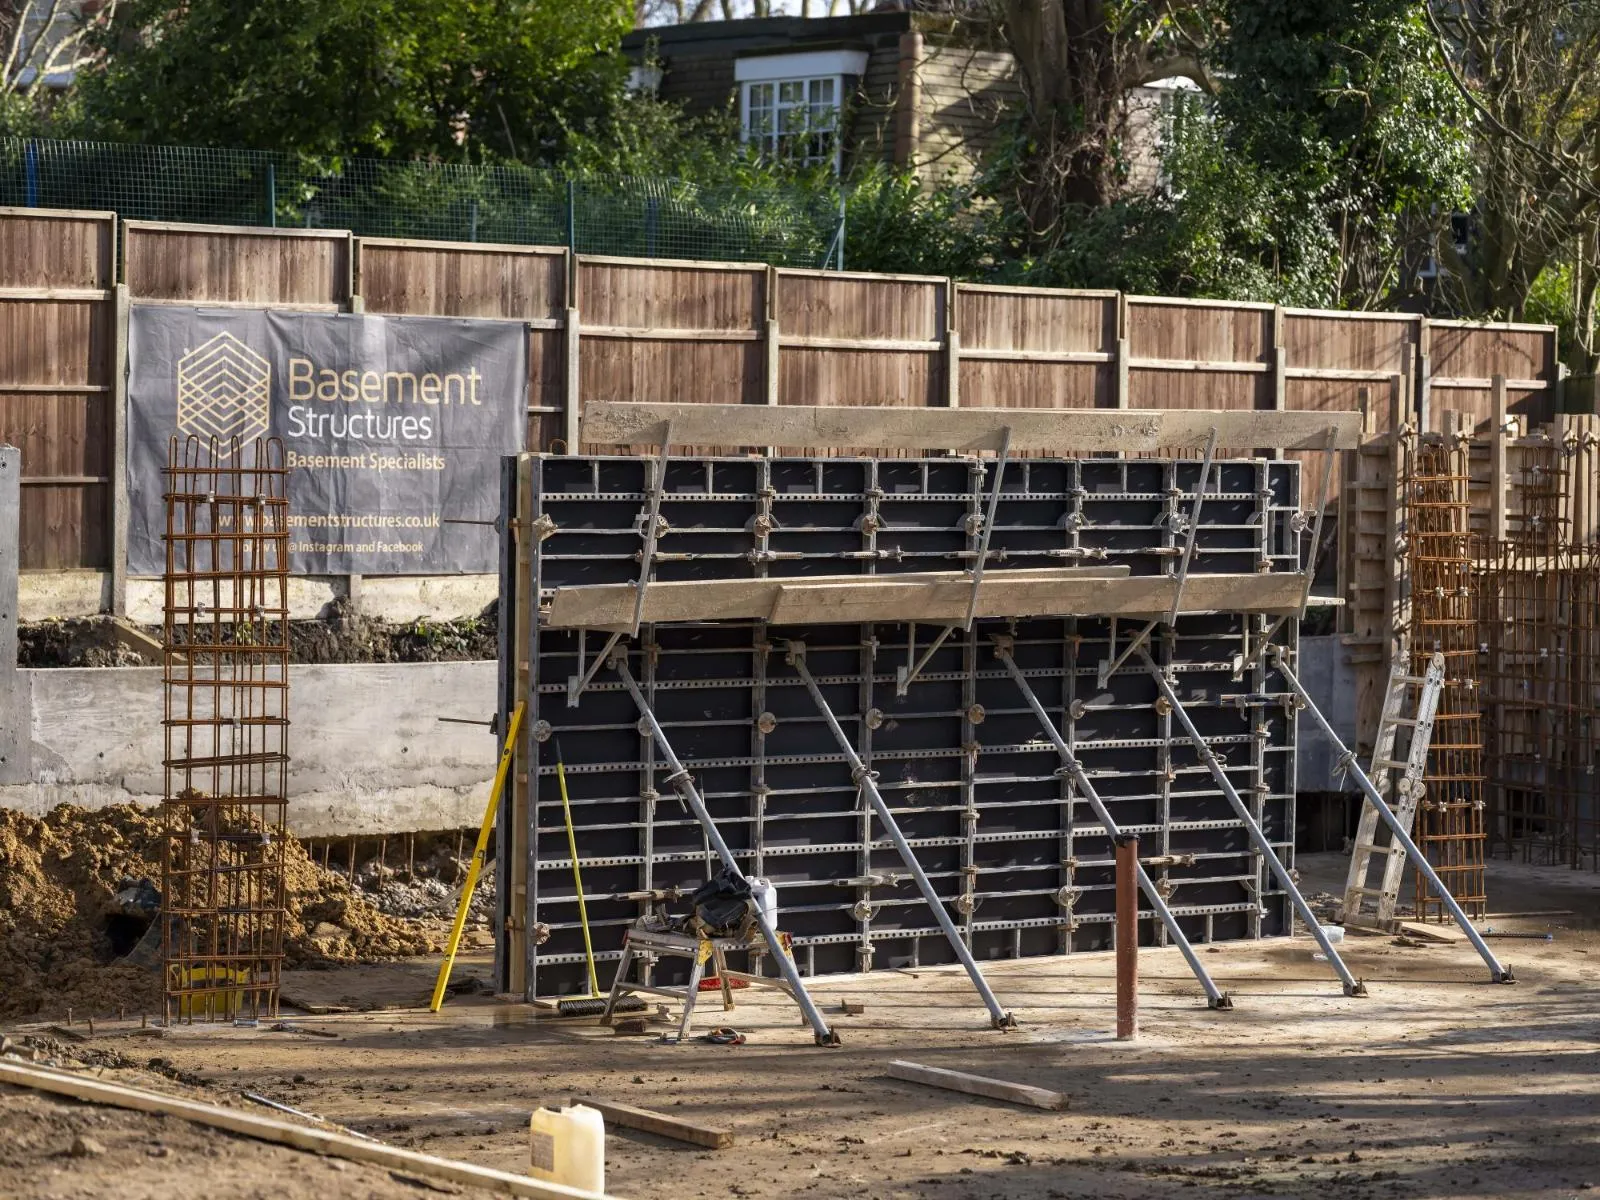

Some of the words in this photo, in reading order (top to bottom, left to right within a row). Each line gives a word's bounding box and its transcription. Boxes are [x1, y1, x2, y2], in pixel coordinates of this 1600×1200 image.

[289, 358, 481, 405] Basement
[288, 405, 433, 440] Structures
[287, 450, 366, 470] Basement
[369, 452, 446, 472] Specialists
[218, 512, 440, 528] wwbaementstructures.co.uk
[287, 542, 297, 554] @
[299, 541, 354, 555] Instagram
[357, 541, 376, 553] and
[377, 541, 424, 553] Facebook
